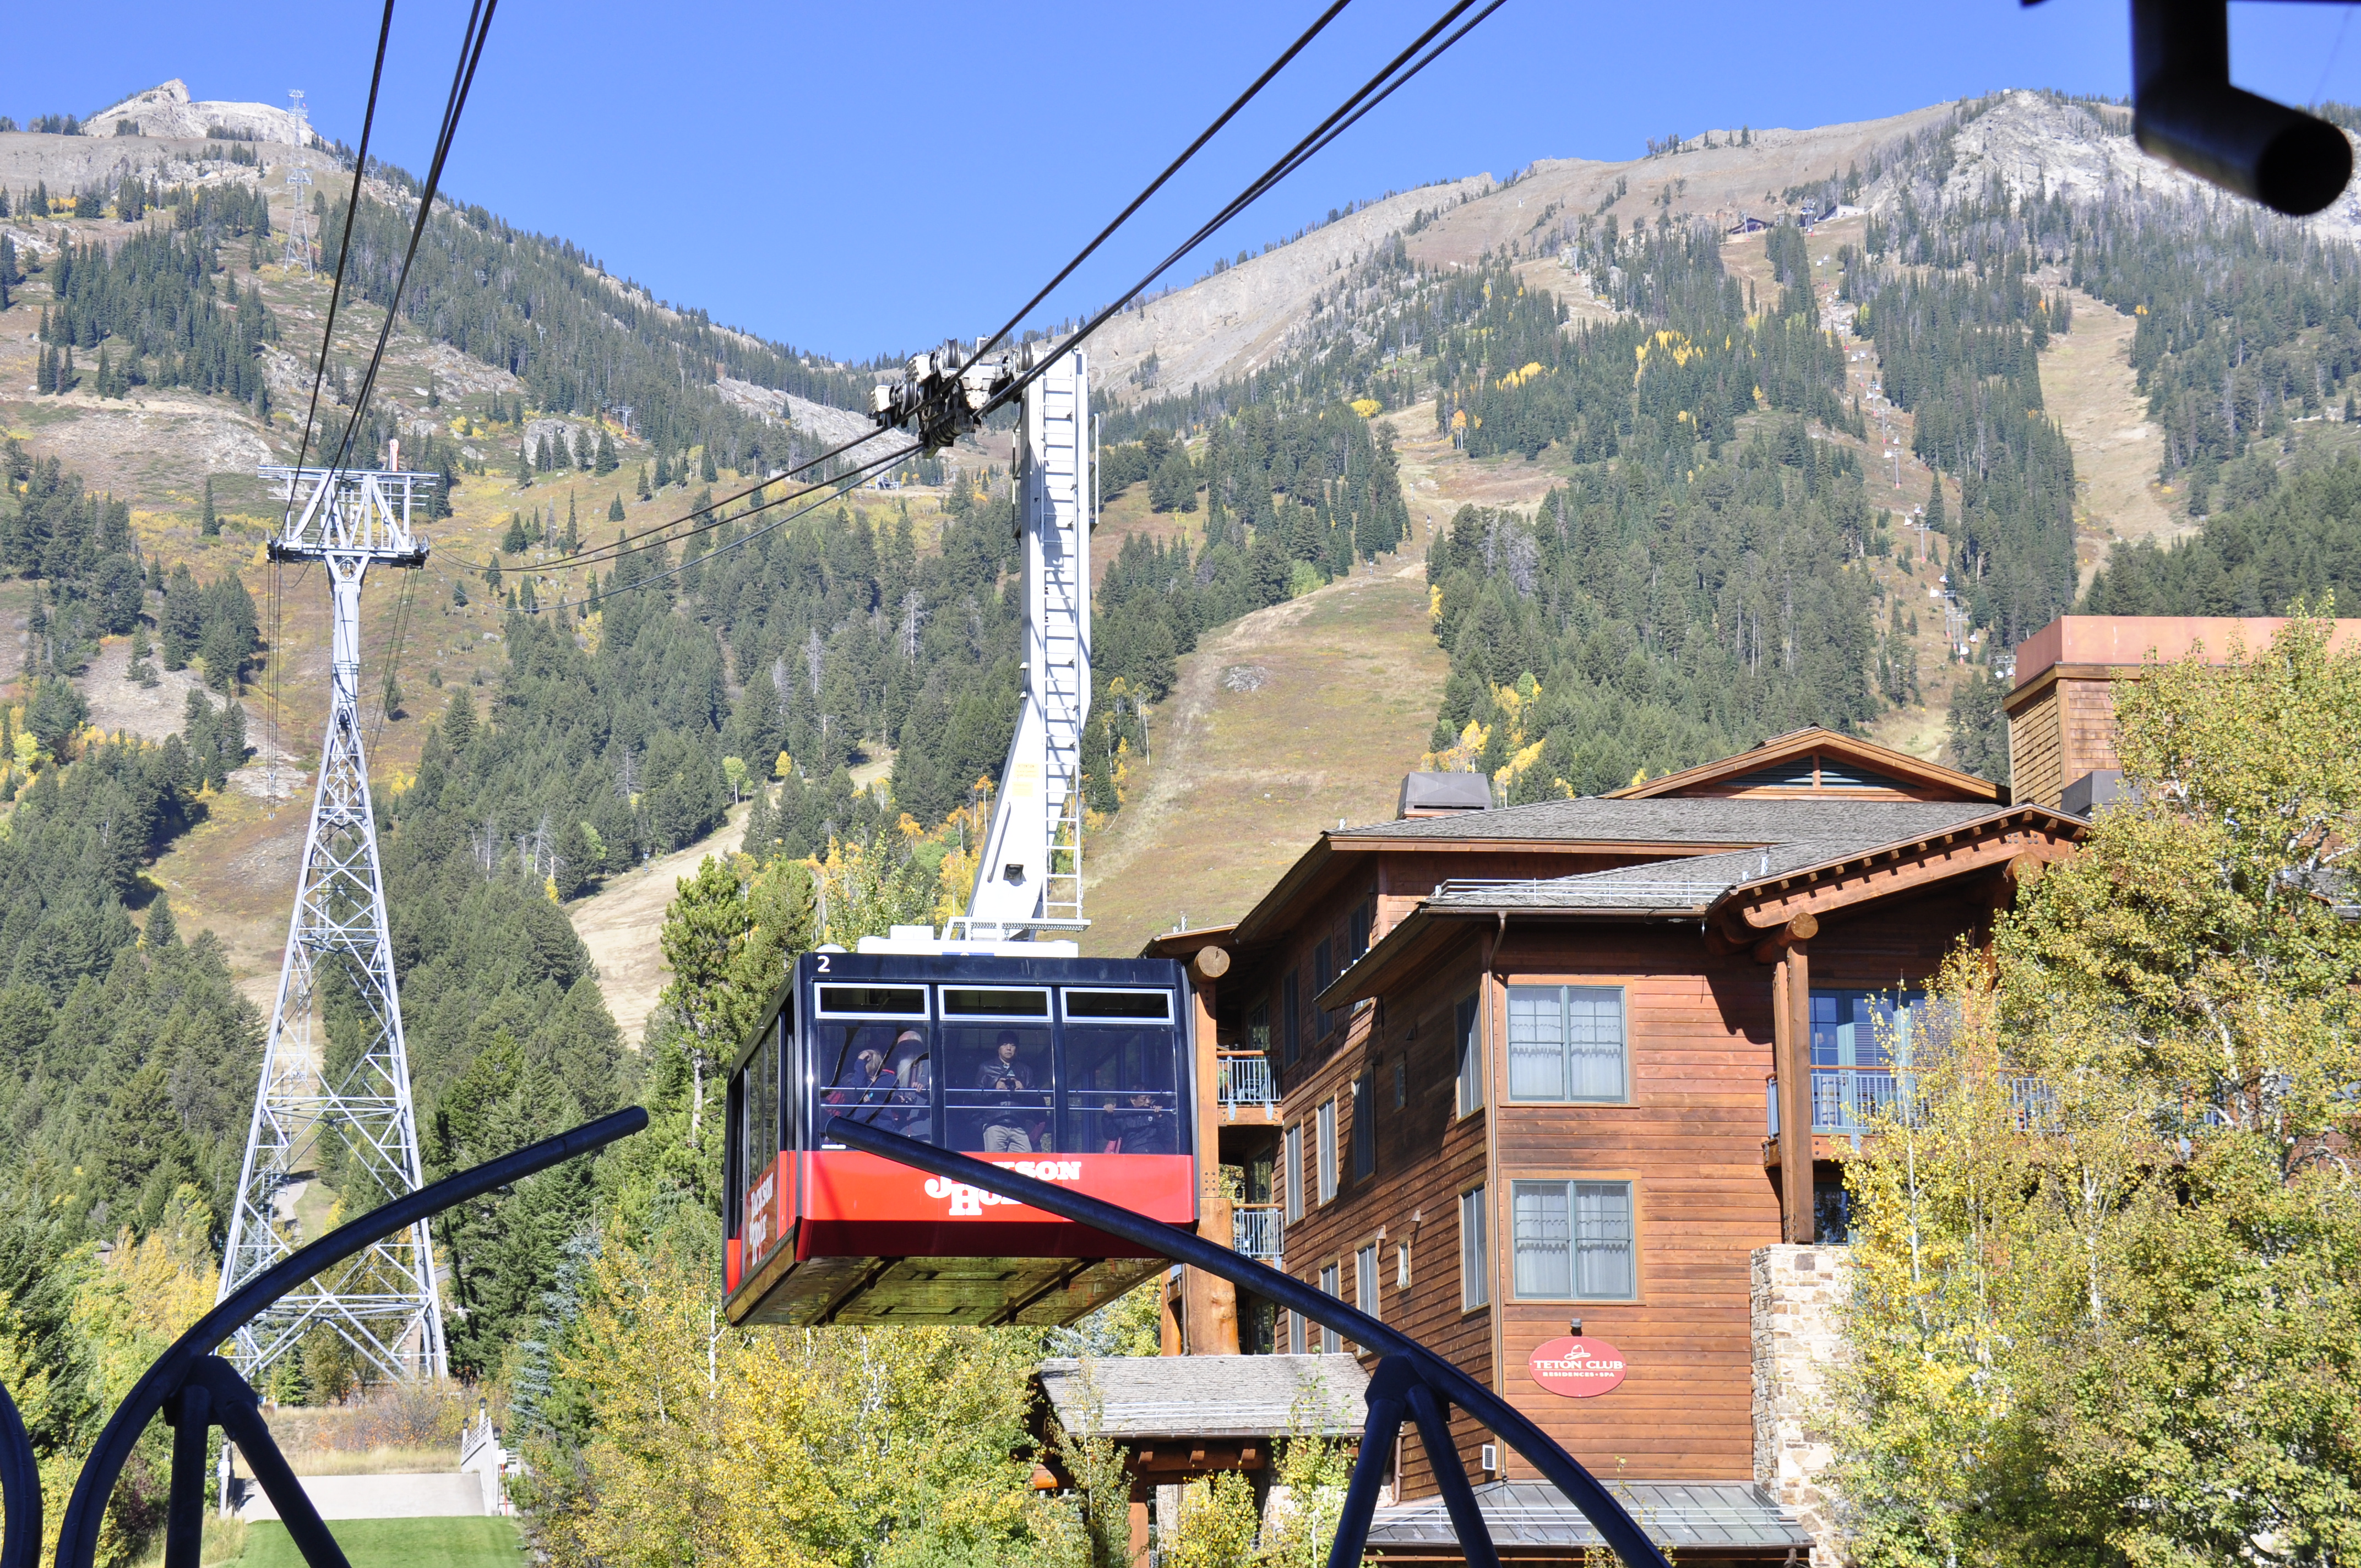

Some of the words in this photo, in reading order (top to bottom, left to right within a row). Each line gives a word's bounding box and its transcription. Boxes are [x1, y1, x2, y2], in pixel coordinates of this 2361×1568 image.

[817, 955, 830, 973] 2
[1533, 1360, 1582, 1369] TETON
[1585, 1360, 1623, 1369] CLUB
